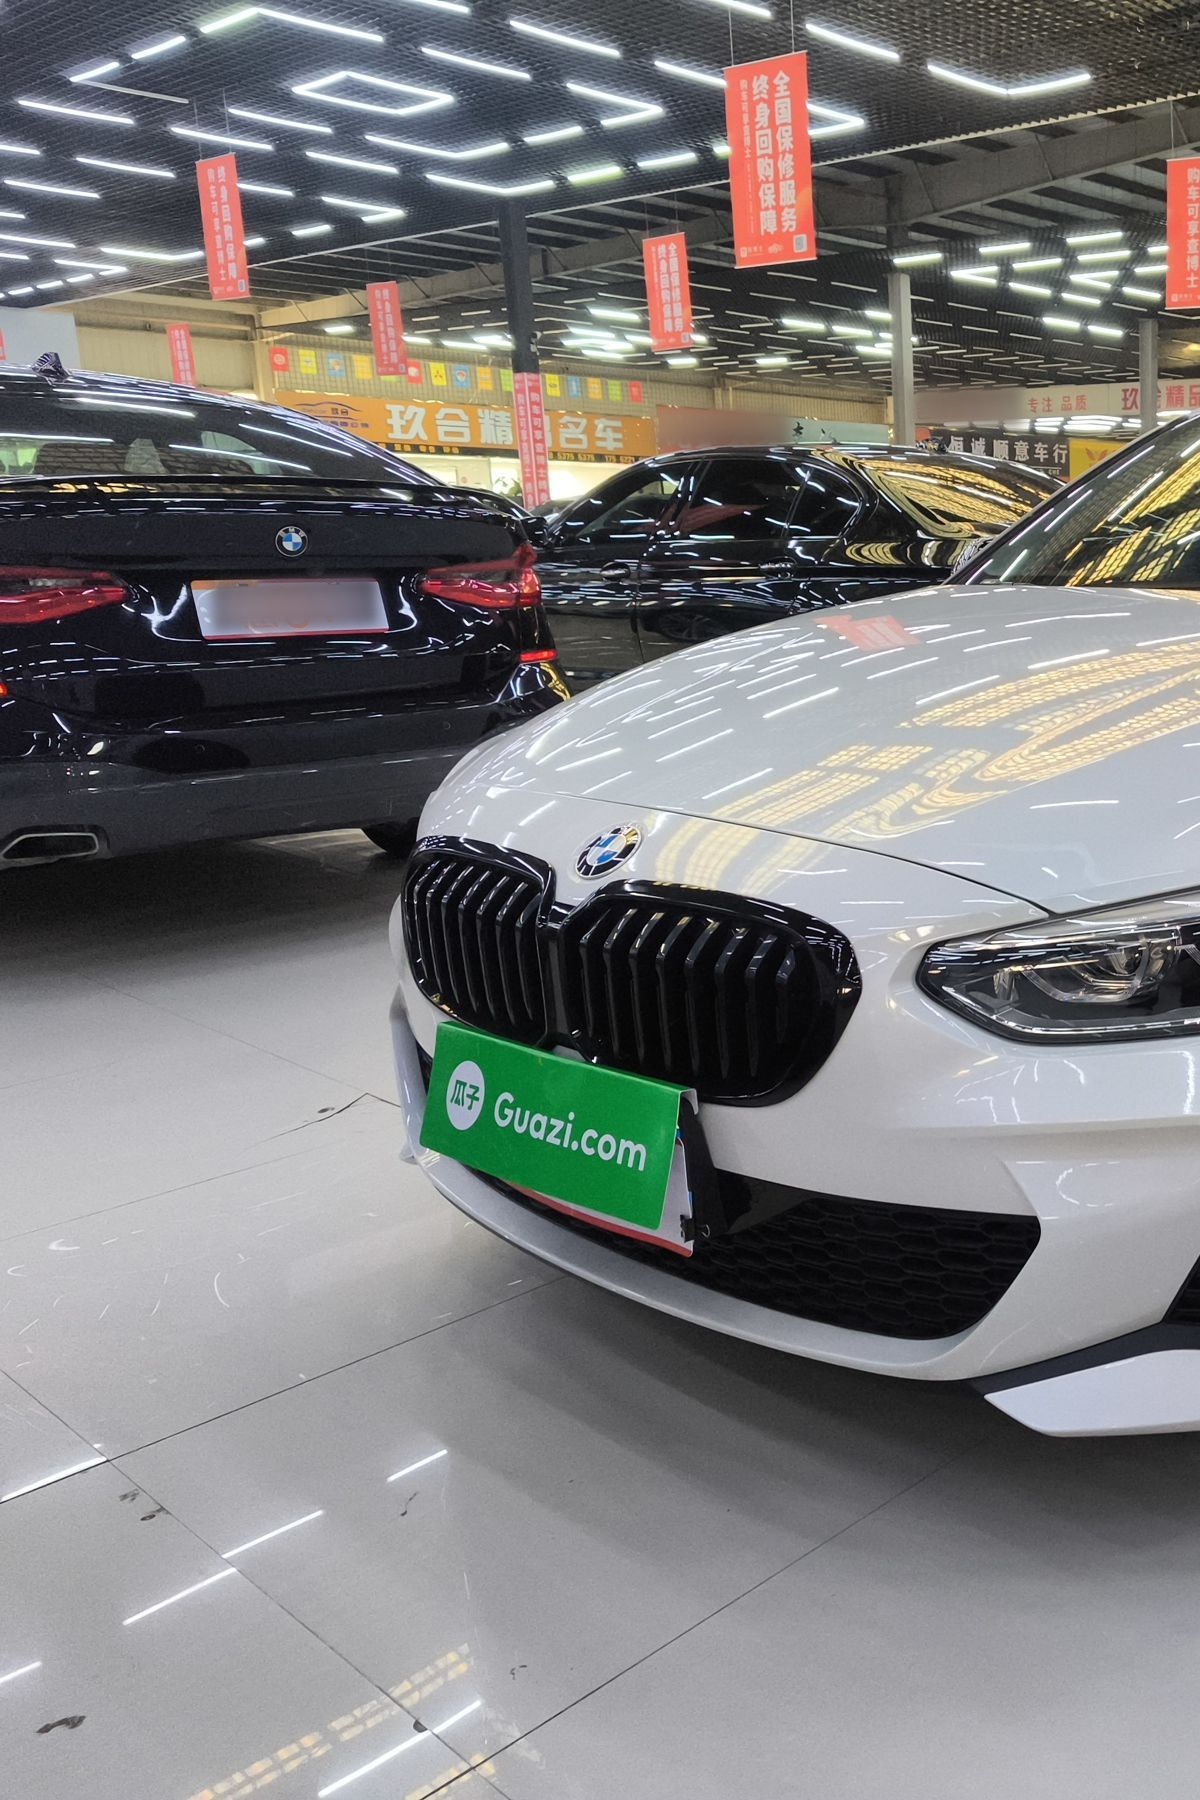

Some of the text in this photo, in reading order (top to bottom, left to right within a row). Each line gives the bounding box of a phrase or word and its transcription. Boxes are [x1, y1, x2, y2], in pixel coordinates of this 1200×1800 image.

[751, 73, 778, 236] 终身回购保障
[772, 69, 798, 233] 全国保修服务
[1185, 168, 1200, 288] 购车可享查博士
[384, 403, 624, 451] 玖合精名车
[1027, 394, 1089, 413] 专注 品质
[449, 1079, 481, 1112] 瓜子
[493, 1091, 647, 1172] Guazi.com
